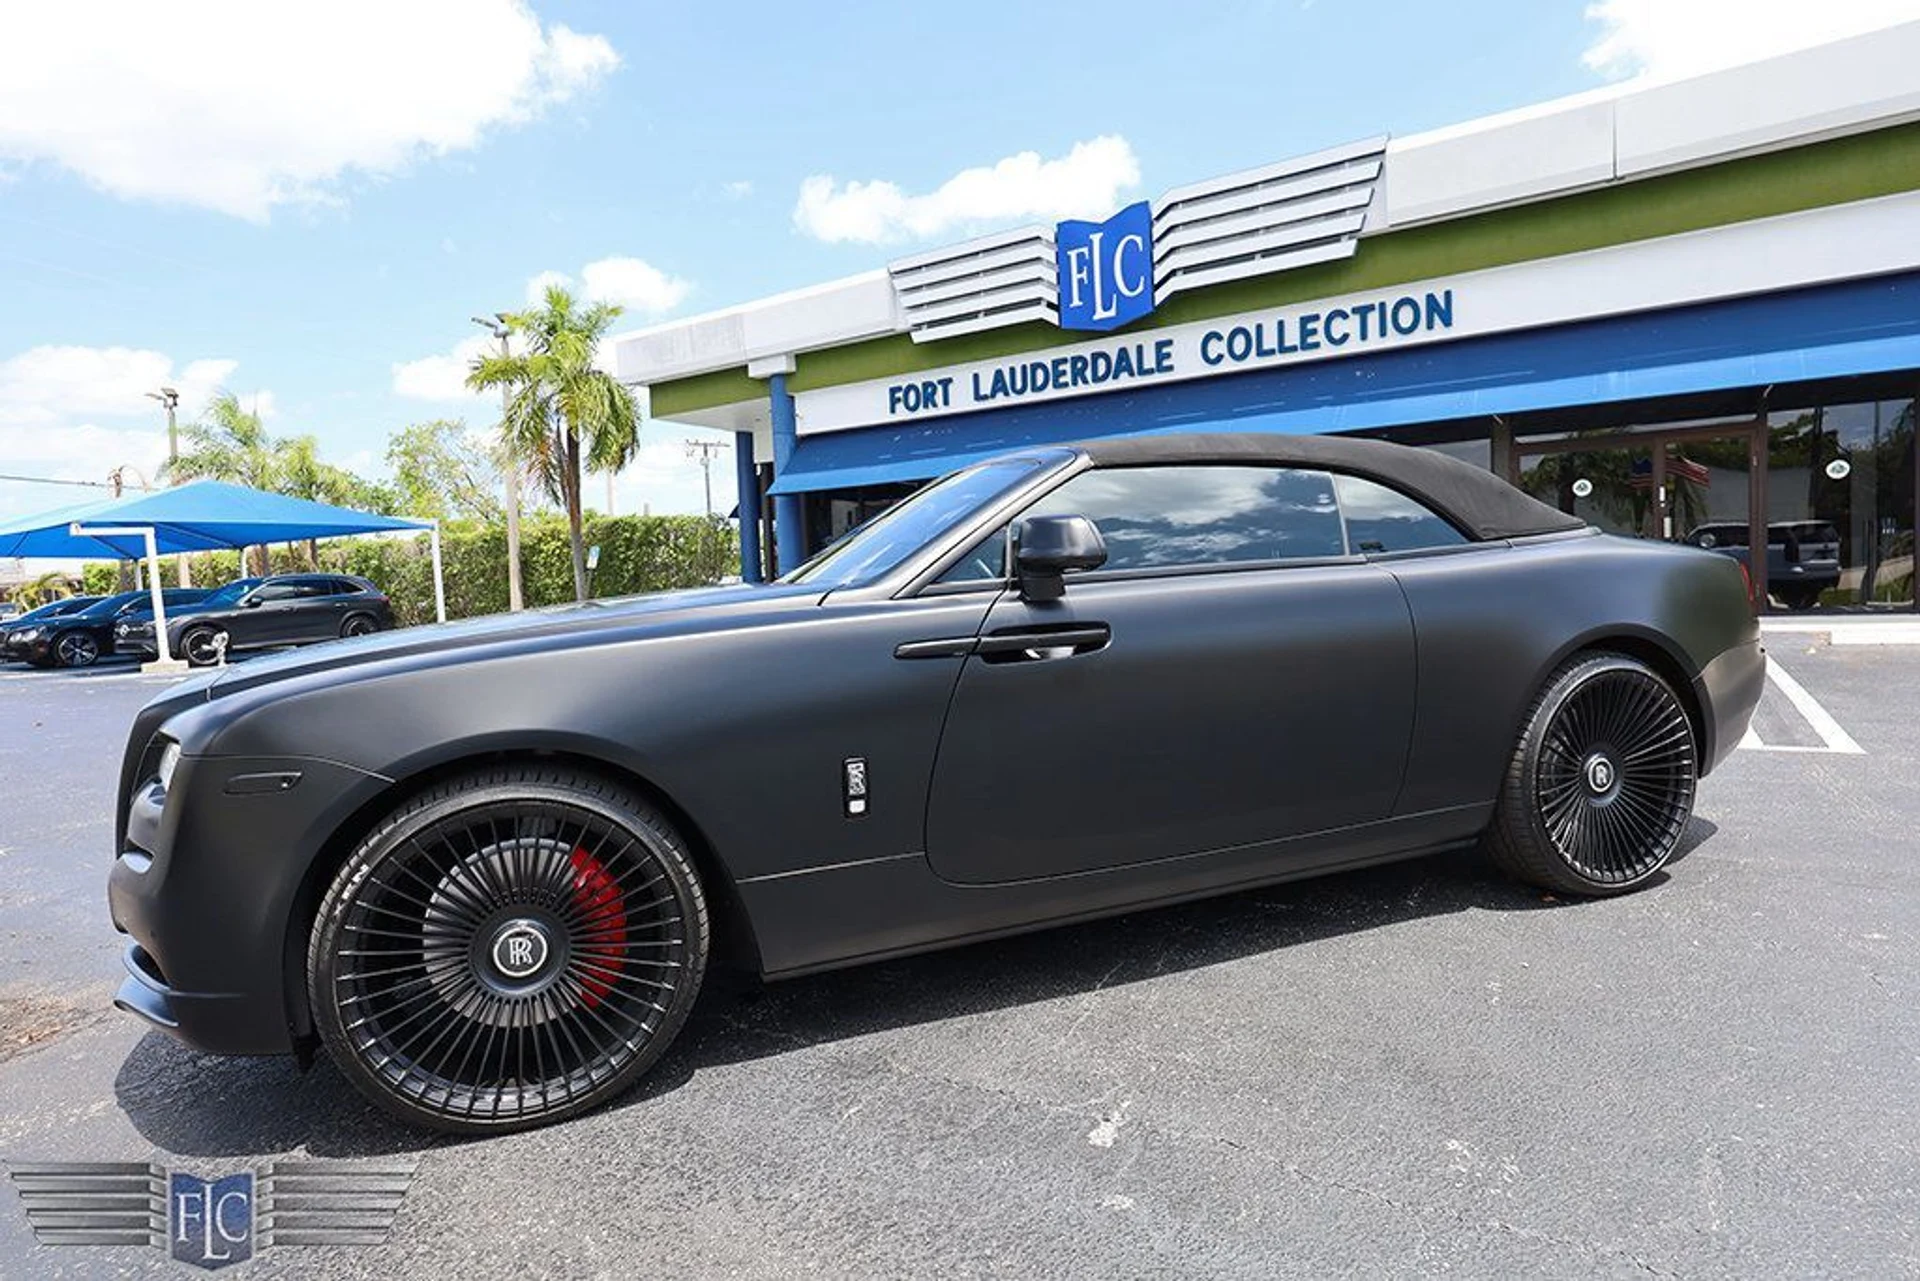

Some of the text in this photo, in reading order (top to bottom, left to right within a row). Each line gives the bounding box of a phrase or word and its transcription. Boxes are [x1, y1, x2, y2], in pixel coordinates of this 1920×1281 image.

[889, 290, 1453, 414] FORT LAUDERDALE COLLECTION
